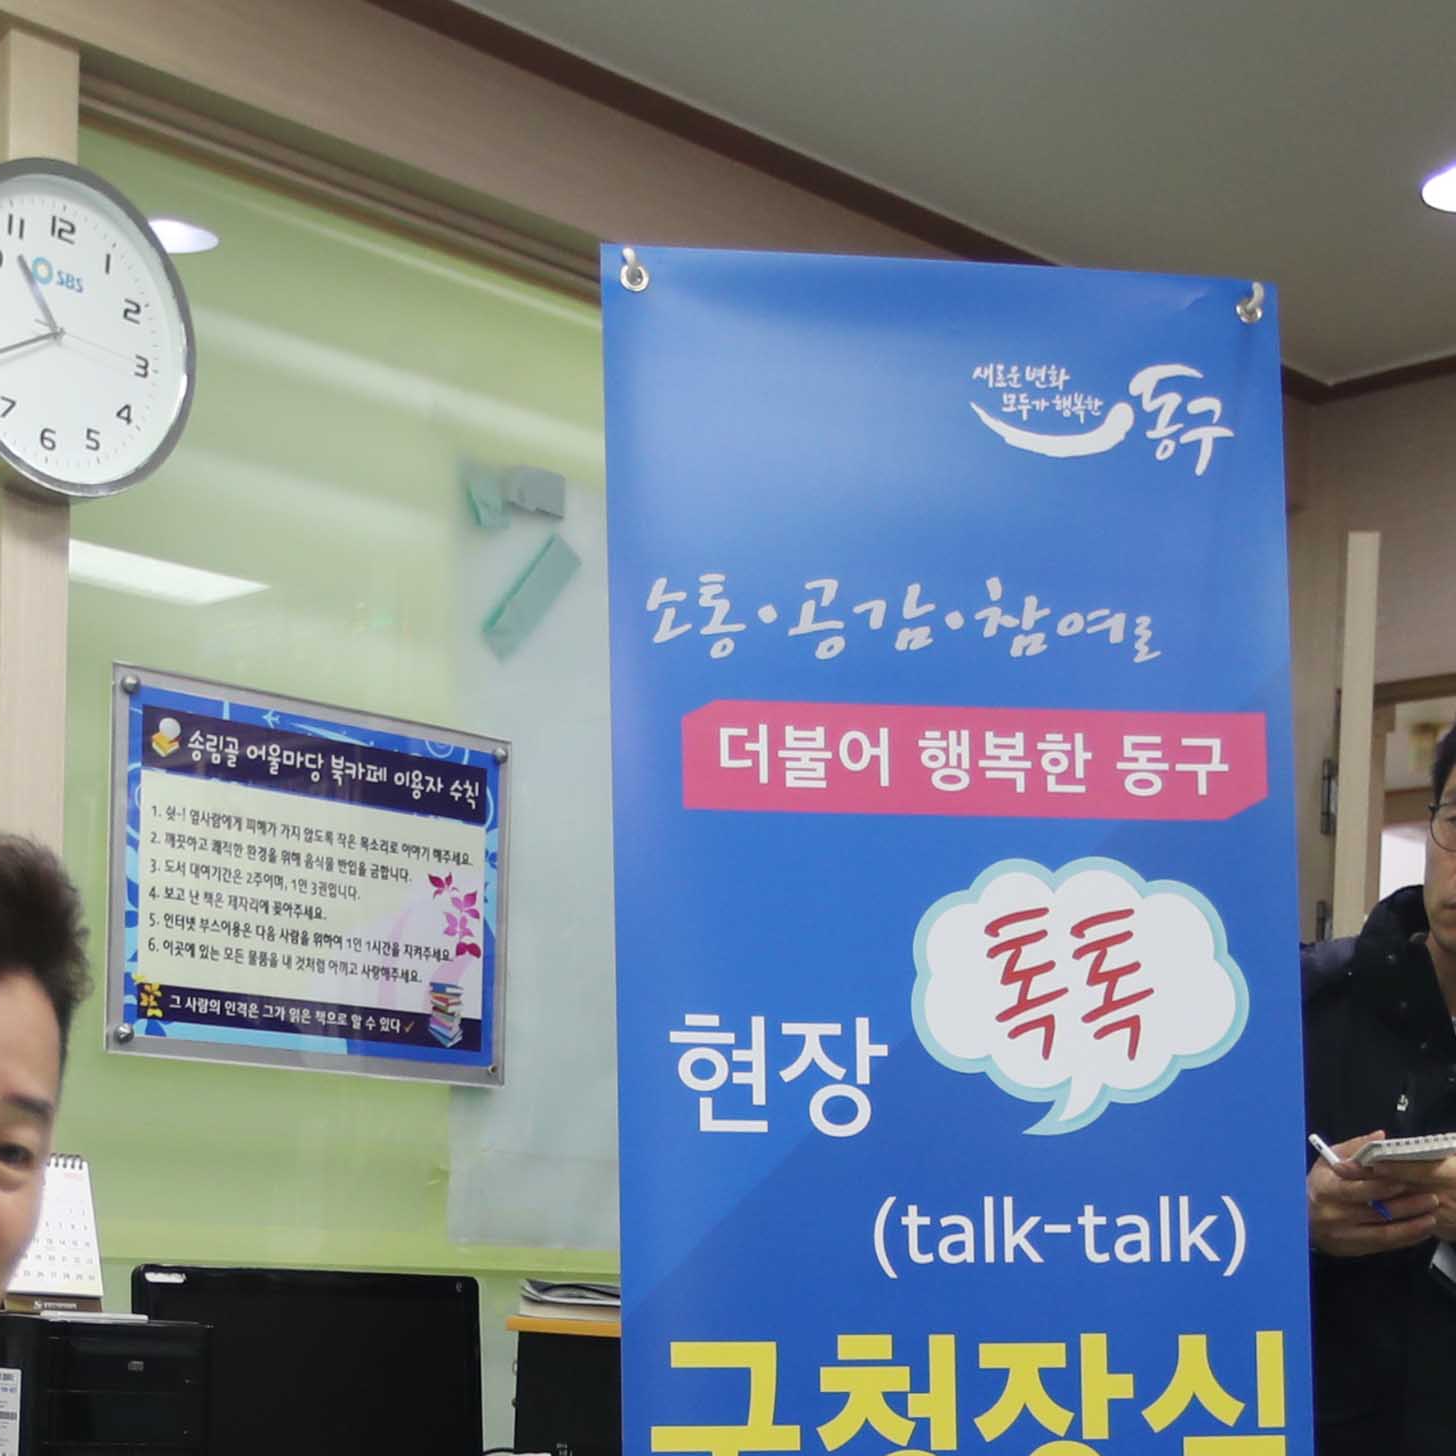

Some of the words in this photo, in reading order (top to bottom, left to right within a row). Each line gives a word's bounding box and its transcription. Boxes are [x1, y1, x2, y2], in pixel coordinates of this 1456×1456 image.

[6, 213, 25, 240] 11
[50, 214, 77, 245] 12
[56, 269, 84, 294] SBS
[123, 298, 142, 325] 2
[134, 355, 150, 379] 3
[971, 364, 1022, 390] 새로운
[1024, 366, 1070, 391] 변화
[0, 396, 17, 419] 7
[115, 403, 133, 425] 4
[1001, 392, 1049, 420] 모두가
[1053, 391, 1103, 425] 행복한
[1128, 363, 1235, 476] 동구
[39, 427, 57, 451] 6
[85, 428, 101, 451] 5
[187, 730, 240, 767] 송림골
[246, 744, 324, 782] 어울마당
[331, 754, 387, 786] 북카페
[394, 770, 444, 799] 이용자
[450, 780, 479, 809] 수칙
[719, 724, 891, 788] 더불어
[917, 729, 1093, 794] 행복한
[1116, 734, 1230, 796] 동구
[152, 806, 162, 817] 1.
[190, 809, 242, 832] 옆사람에게
[246, 817, 276, 837] 피해가
[281, 824, 300, 840] 가지
[303, 826, 334, 846] 않도록
[337, 832, 356, 849] 작은
[361, 836, 398, 855] 목소리로
[401, 843, 430, 861] 이야기
[150, 832, 160, 844] 2.
[165, 832, 207, 851] 깨끗하고
[211, 840, 242, 858] 쾌적한
[247, 844, 277, 863] 환경을
[281, 850, 300, 867] 위해
[303, 852, 334, 872] 음식물
[337, 858, 366, 877] 반입을
[150, 859, 160, 873] 3.
[164, 859, 186, 875] 도서
[189, 862, 243, 886] 대여기간은
[292, 879, 307, 894] 1인
[149, 887, 160, 898] 4.
[164, 887, 185, 900] 보고
[189, 890, 199, 905] 난
[203, 891, 224, 909] 책은
[228, 894, 269, 914] 제자리에
[149, 914, 159, 926] 5.
[164, 913, 196, 932] 인터넷
[199, 918, 252, 938] 부스이용은
[256, 925, 276, 942] 다음
[280, 928, 309, 946] 사람을
[313, 932, 342, 949] 위하여
[346, 937, 362, 952] 1인
[366, 941, 400, 958] 1시간을
[148, 937, 159, 952] 6.
[163, 939, 196, 958] 이곳에
[199, 943, 220, 960] 있는
[224, 947, 244, 963] 모든
[248, 951, 278, 969] 물품을
[282, 955, 292, 969] 내
[295, 955, 325, 974] 것처럼
[328, 959, 358, 976] 아끼고
[169, 995, 181, 1008] 그
[185, 996, 221, 1015] 사람의
[225, 1000, 259, 1018] 인격은
[263, 1005, 285, 1021] 그가
[289, 1008, 311, 1025] 읽은
[316, 1010, 348, 1025] 책으로
[351, 1014, 362, 1030] 알
[366, 1017, 376, 1031] 수
[379, 1019, 401, 1033] 있다
[668, 1013, 888, 1138] 현장
[984, 906, 1155, 1061] 톡톡
[874, 1195, 1247, 1279] (talk-talk)
